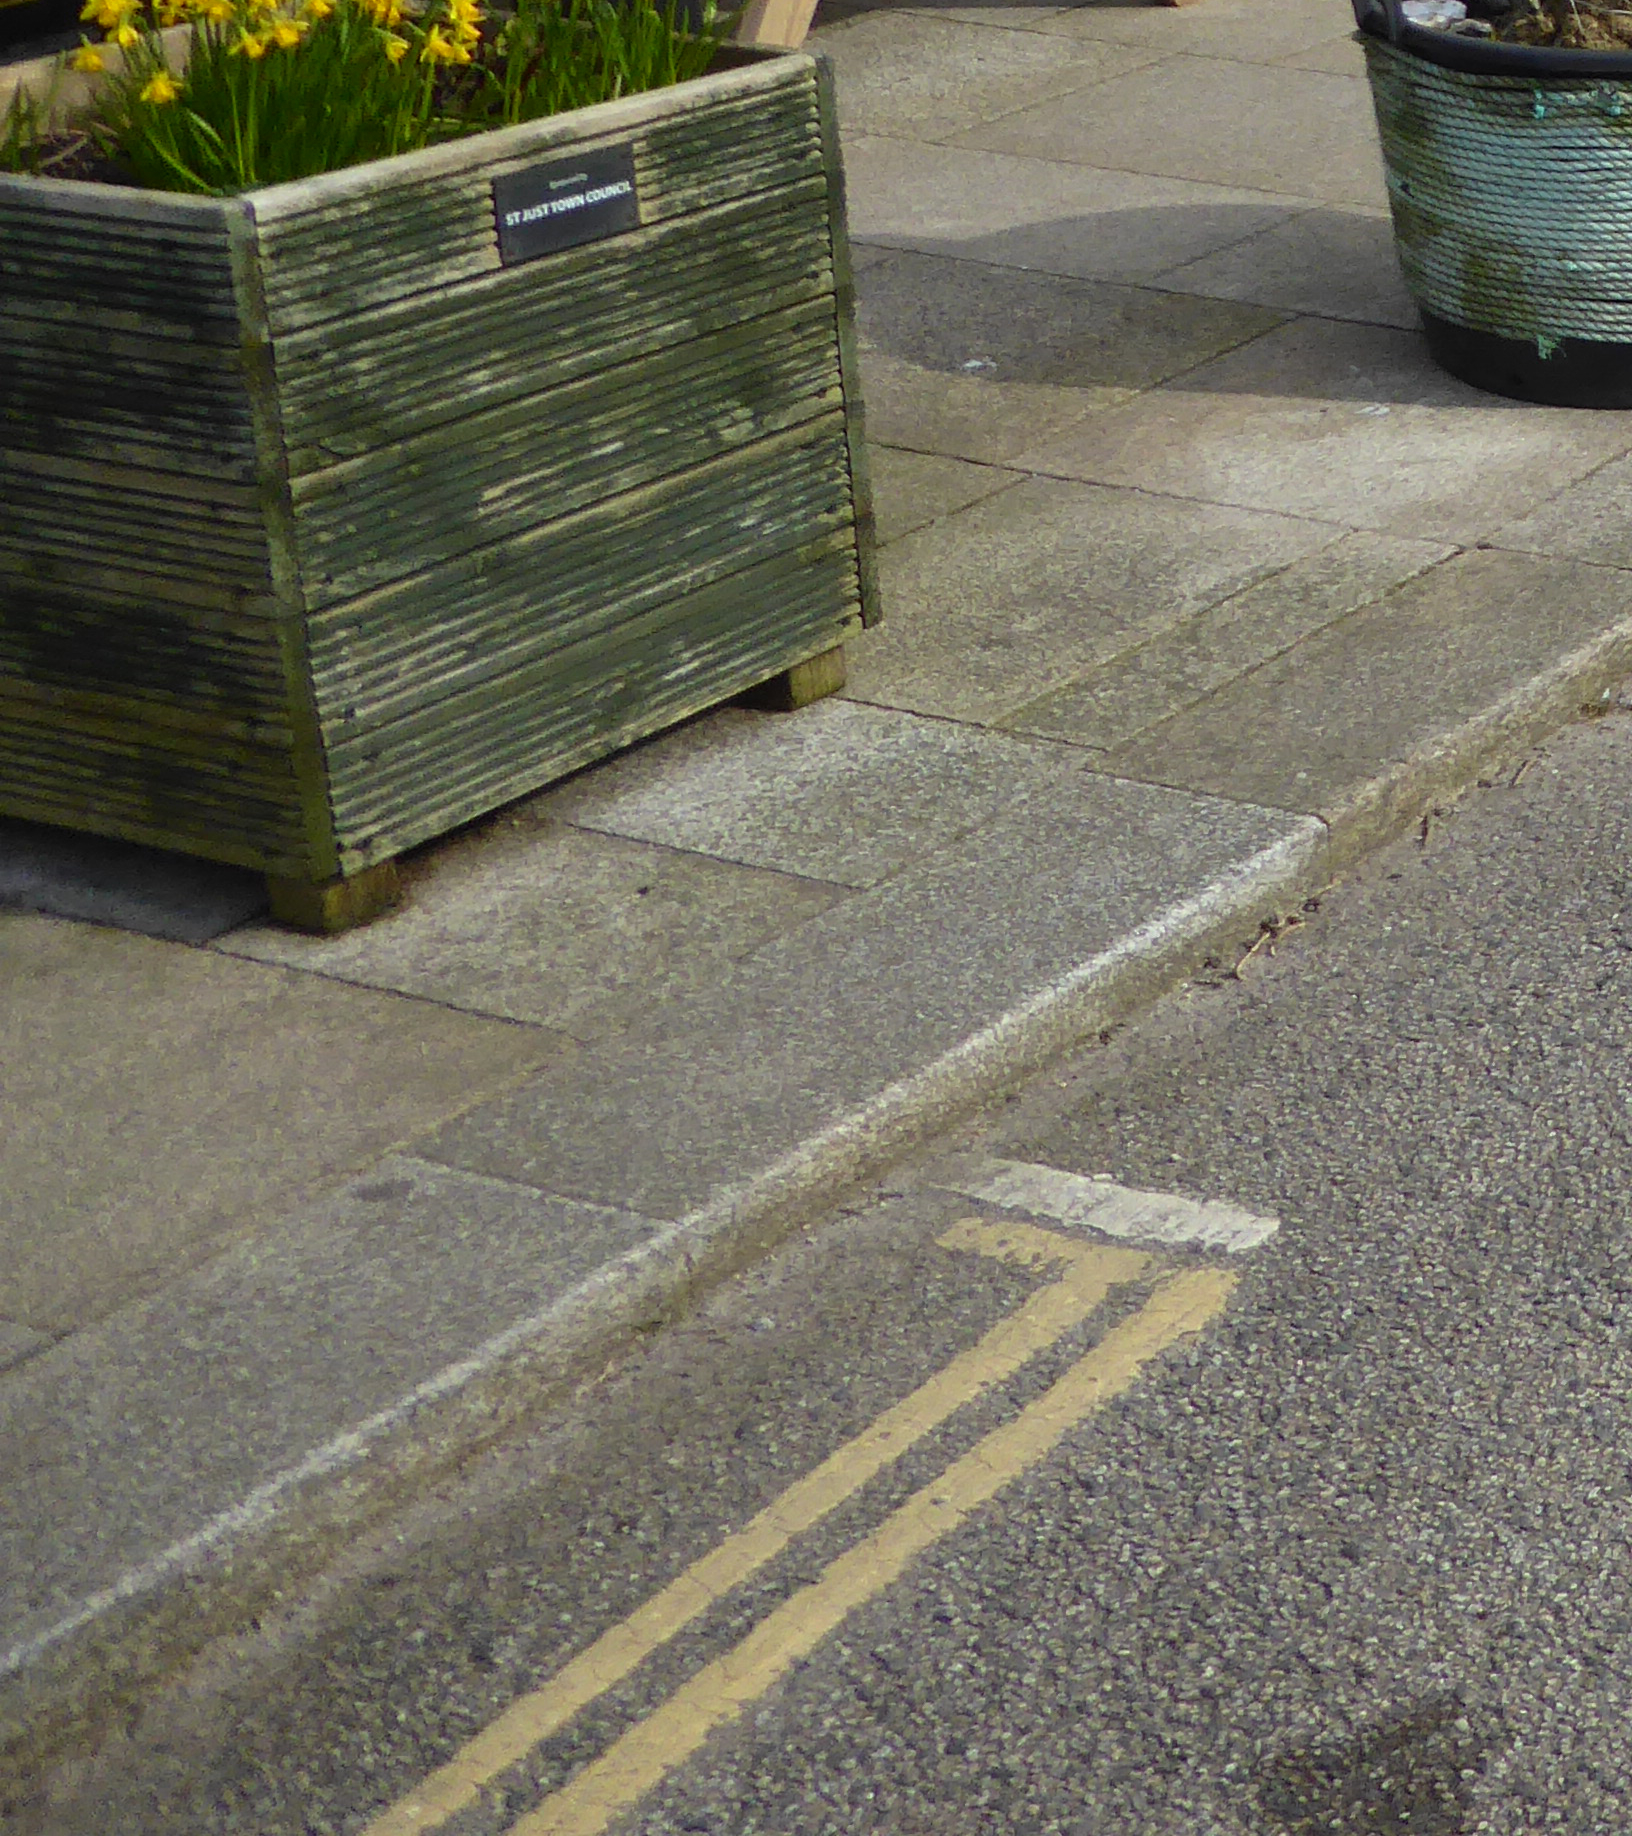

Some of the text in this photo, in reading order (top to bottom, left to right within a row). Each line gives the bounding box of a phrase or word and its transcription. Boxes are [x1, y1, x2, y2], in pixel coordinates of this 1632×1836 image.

[505, 210, 522, 226] ST
[522, 202, 551, 222] JUST
[550, 194, 585, 212] TOWN
[585, 180, 633, 204] COUNCIL
